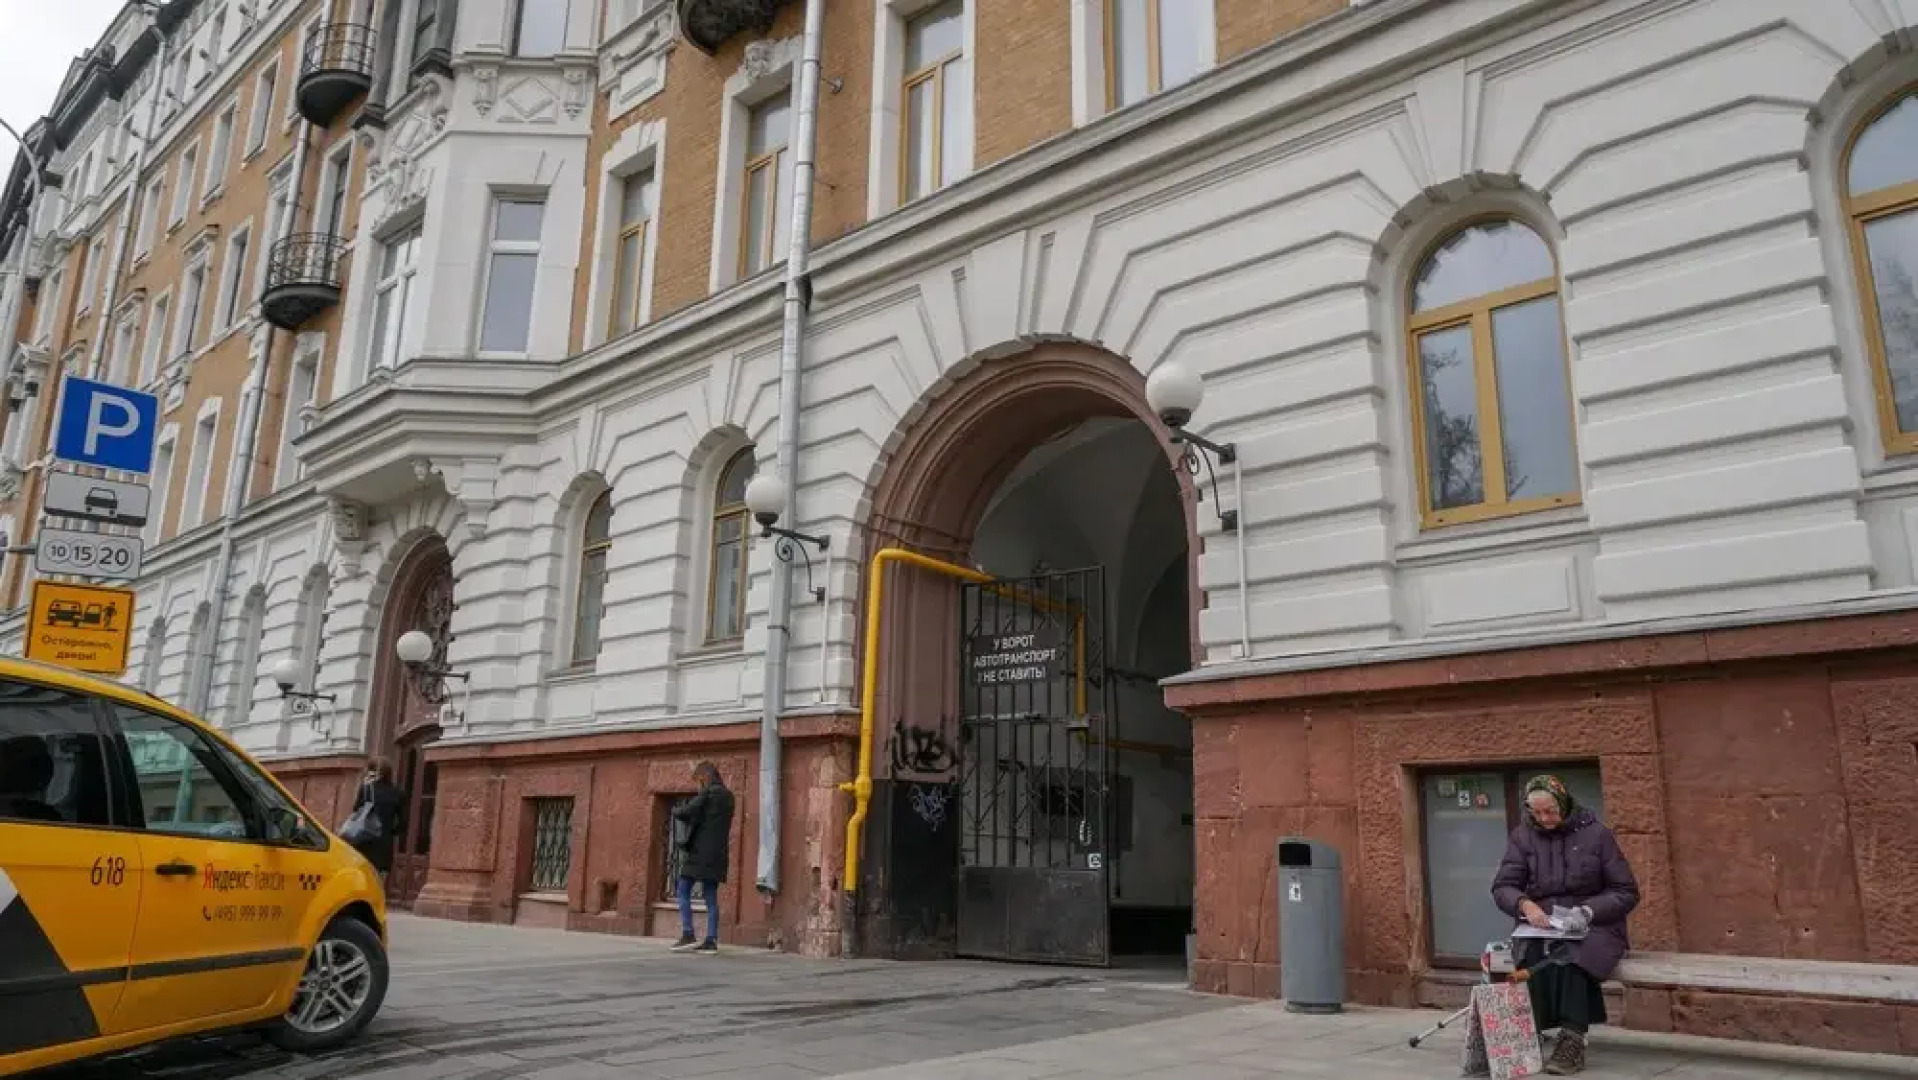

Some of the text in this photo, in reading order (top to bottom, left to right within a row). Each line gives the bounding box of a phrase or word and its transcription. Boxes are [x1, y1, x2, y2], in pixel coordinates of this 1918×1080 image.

[83, 390, 141, 456] P
[51, 545, 128, 566] 10 15 20
[993, 634, 1035, 650] У ВОРОТ
[974, 648, 1056, 668] АВТОТРАНСПОРТ
[90, 857, 126, 887] 618
[203, 862, 253, 892] Яндекс
